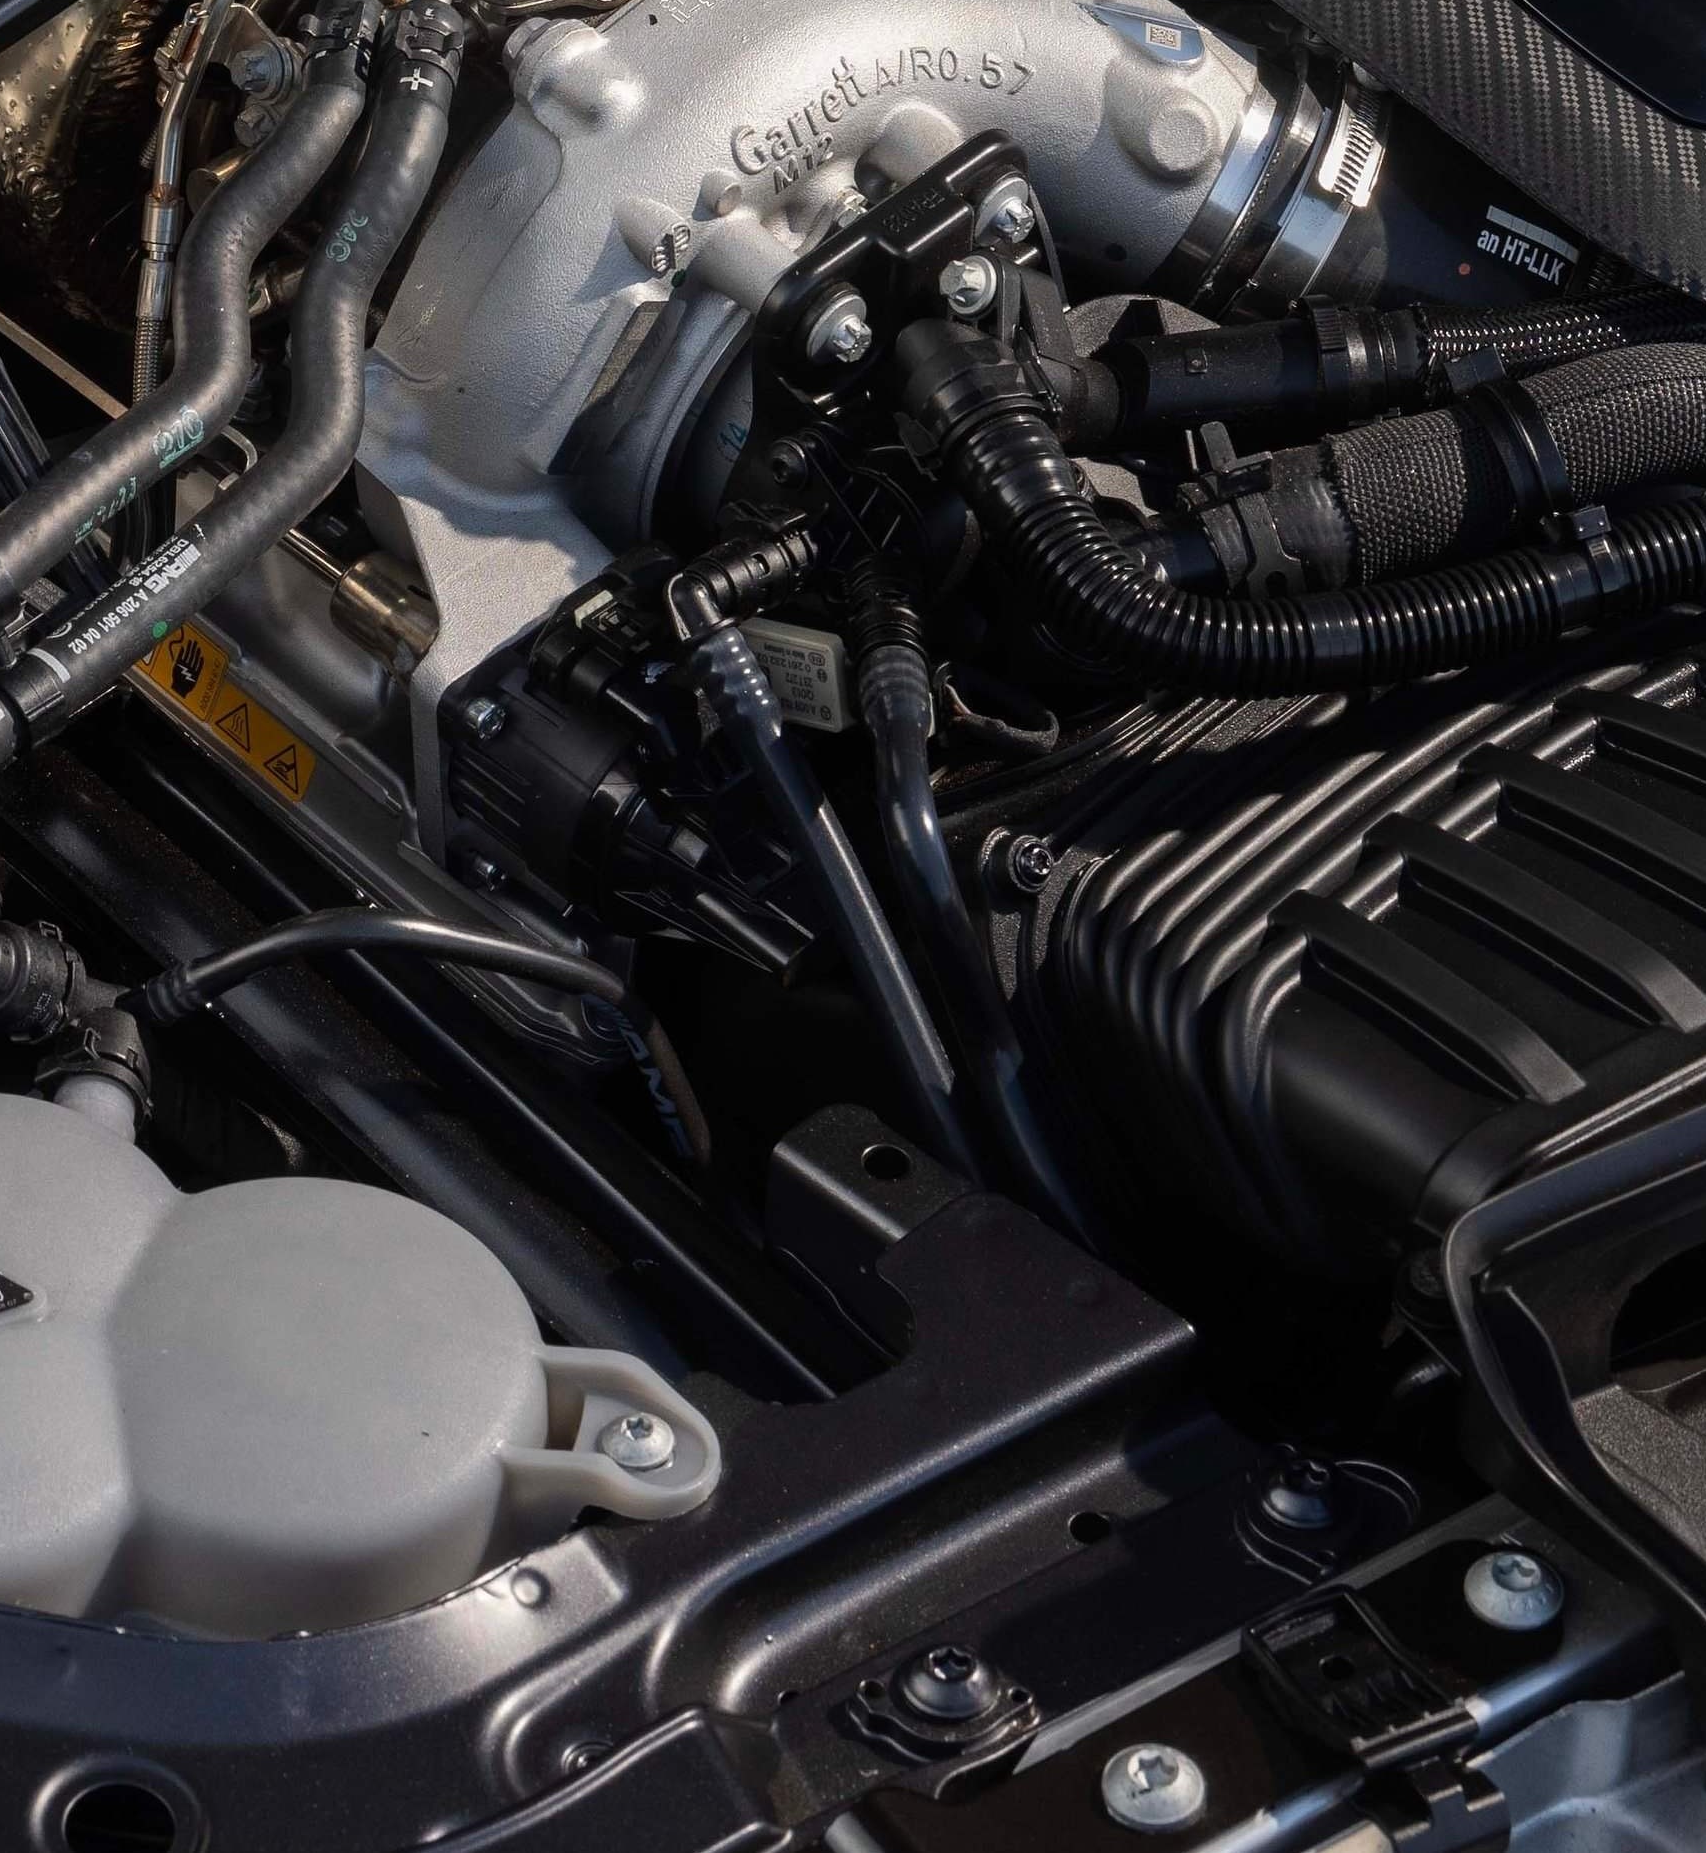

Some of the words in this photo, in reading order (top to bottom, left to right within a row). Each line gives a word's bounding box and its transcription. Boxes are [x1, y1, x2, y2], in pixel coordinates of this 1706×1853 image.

[731, 56, 868, 175] Garrett
[773, 132, 834, 195] M12
[1477, 228, 1498, 255] an
[1501, 235, 1566, 286] HT-LLK
[113, 594, 139, 619] 206
[131, 587, 147, 603] A
[95, 610, 119, 633] 501
[66, 635, 86, 656] 02
[79, 624, 101, 646] 04
